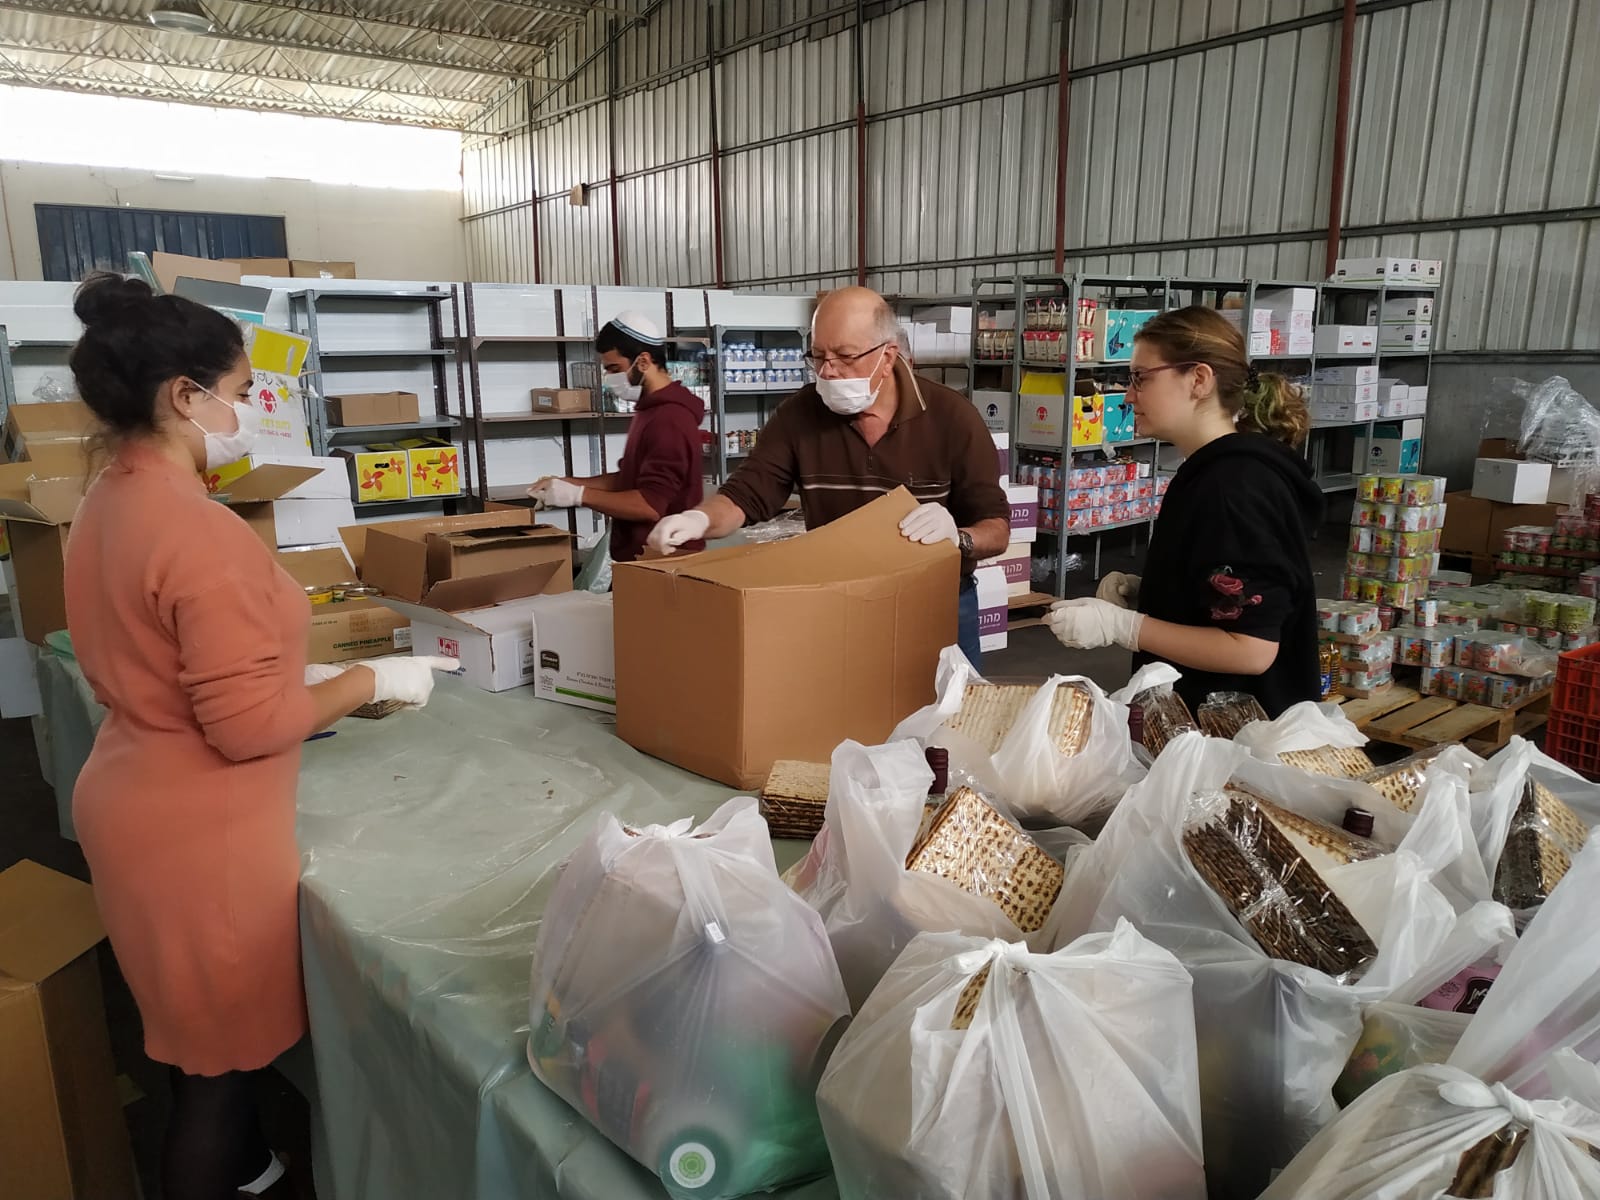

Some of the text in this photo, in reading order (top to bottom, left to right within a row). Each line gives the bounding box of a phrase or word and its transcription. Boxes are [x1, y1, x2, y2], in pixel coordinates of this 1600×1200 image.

[1011, 508, 1029, 519] מהו
[333, 641, 359, 649] CANNED
[360, 636, 392, 646] PINEAPPLE
